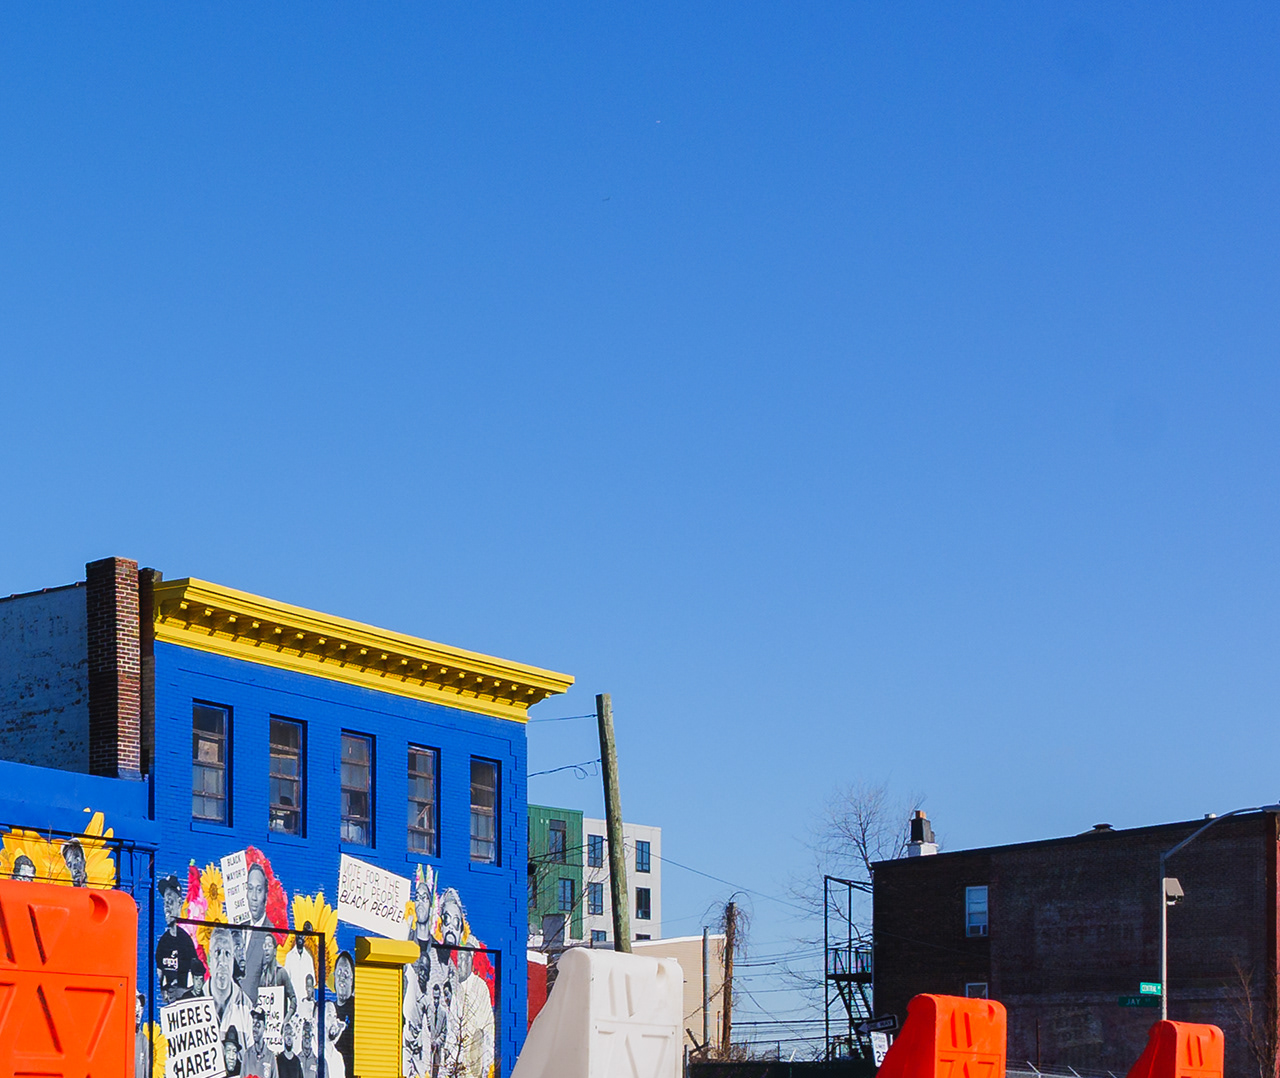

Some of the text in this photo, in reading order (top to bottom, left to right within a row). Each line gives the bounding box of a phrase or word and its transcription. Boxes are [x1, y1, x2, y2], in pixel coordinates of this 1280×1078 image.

[341, 874, 400, 908] RIGHT PEOPLE
[343, 860, 400, 894] VOTE FOR THE
[339, 889, 370, 911] BLACK
[1126, 998, 1141, 1006] JAY
